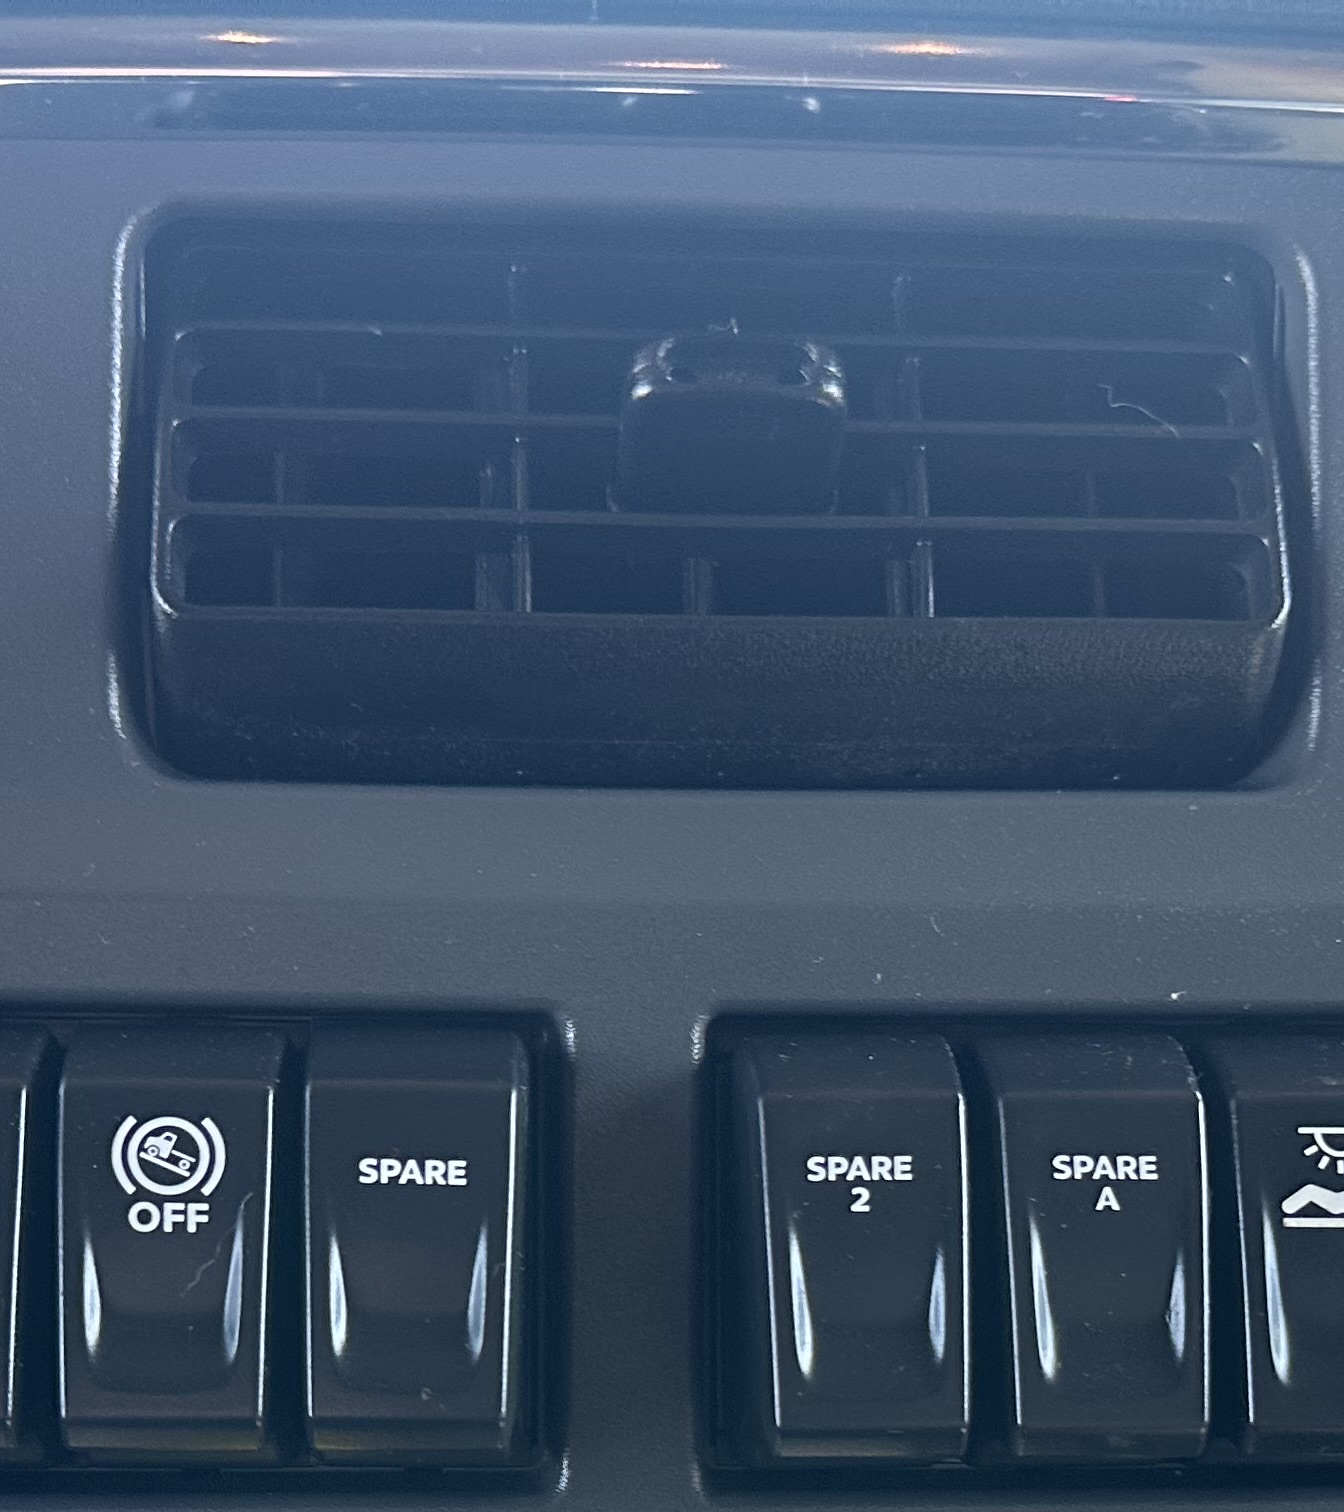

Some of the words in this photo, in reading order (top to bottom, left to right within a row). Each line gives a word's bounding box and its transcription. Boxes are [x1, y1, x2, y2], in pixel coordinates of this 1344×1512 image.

[358, 1158, 468, 1186] SPARE
[806, 1155, 913, 1182] SPARE
[1052, 1154, 1158, 1180] SPARE
[850, 1187, 870, 1212] 2
[1095, 1187, 1120, 1211] A
[127, 1202, 209, 1233] OFF
